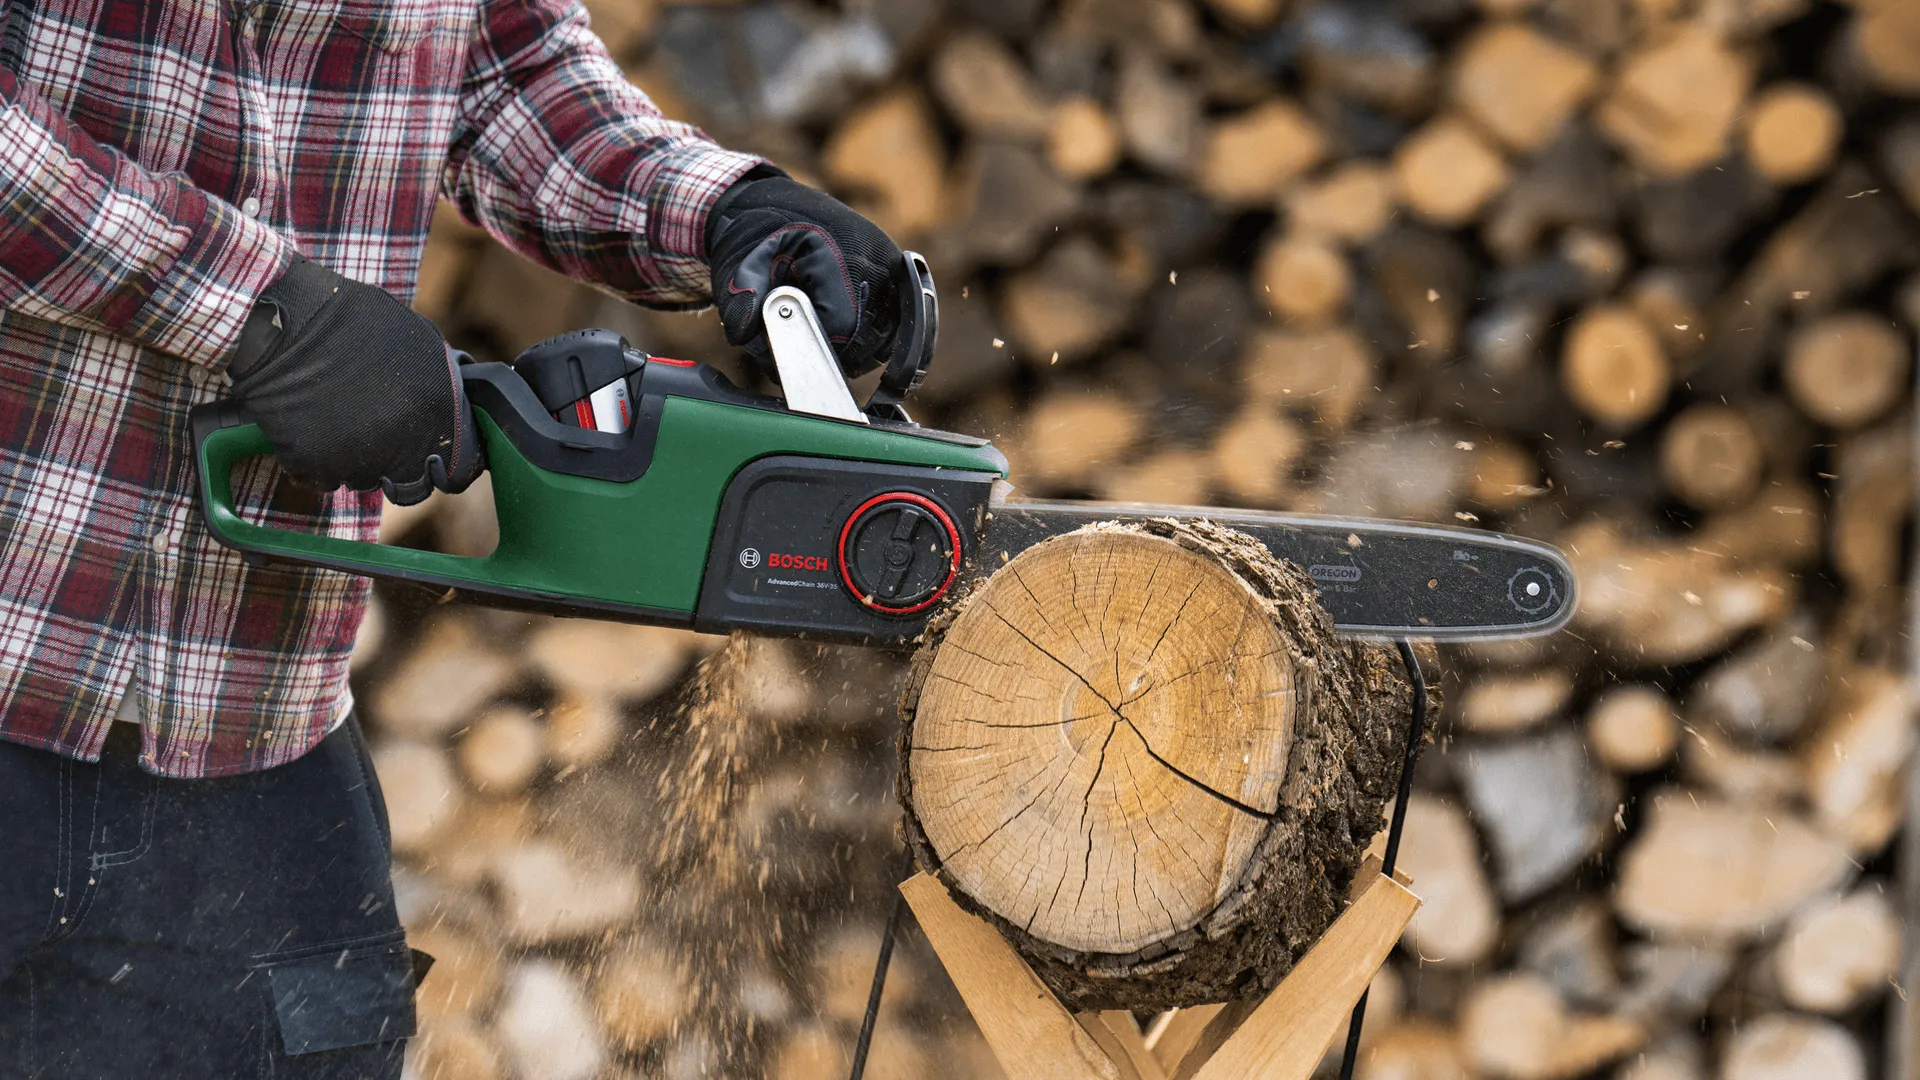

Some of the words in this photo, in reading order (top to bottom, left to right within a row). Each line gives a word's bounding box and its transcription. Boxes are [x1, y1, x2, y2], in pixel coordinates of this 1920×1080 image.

[768, 553, 828, 571] BOSCH
[1312, 568, 1355, 578] OREGON
[767, 578, 815, 588] AdvancedChain
[817, 582, 838, 590] 36V-35
